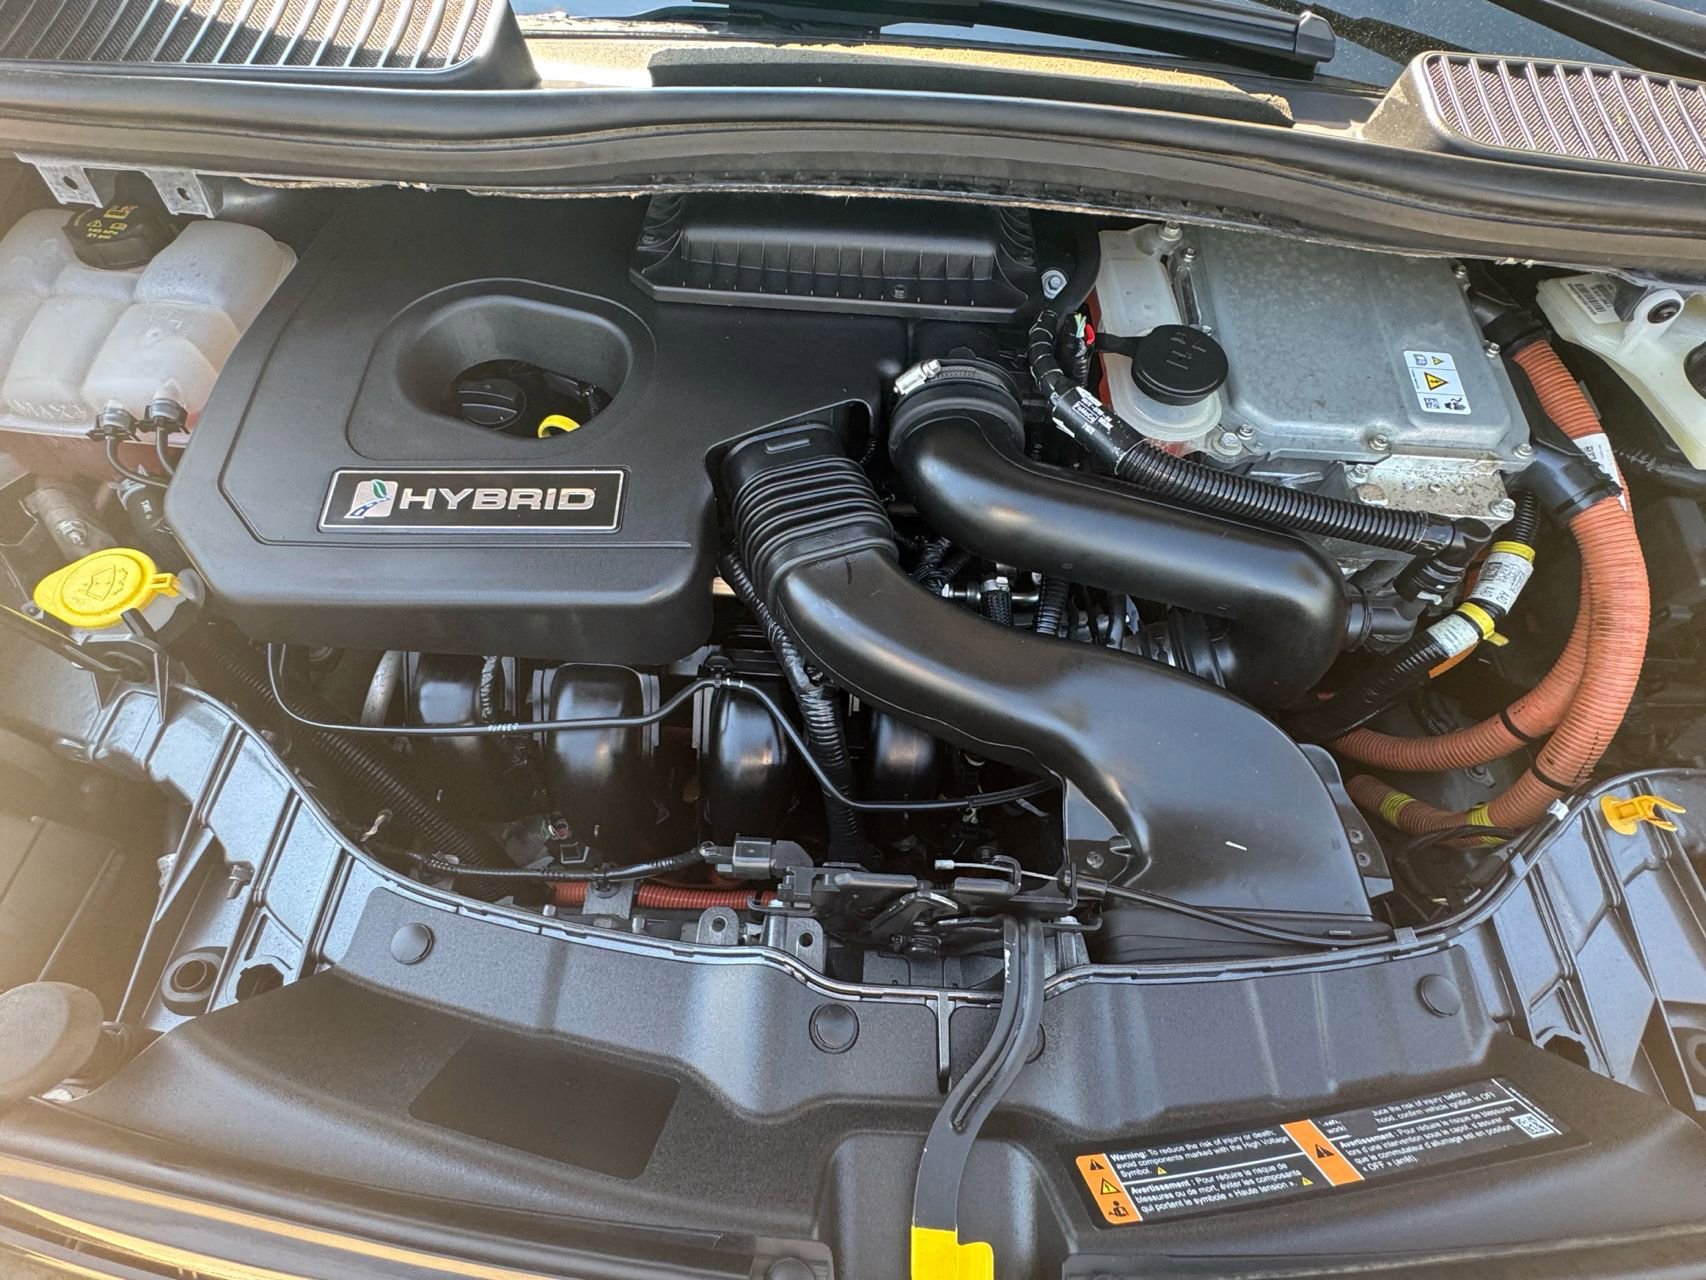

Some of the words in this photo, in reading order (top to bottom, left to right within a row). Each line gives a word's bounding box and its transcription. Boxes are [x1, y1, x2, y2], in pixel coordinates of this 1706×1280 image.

[400, 488, 596, 511] HYBRID
[1398, 1110, 1424, 1119] confirm
[1423, 1104, 1449, 1113] vehicle
[1448, 1098, 1475, 1109] ignition
[1443, 1091, 1468, 1101] before
[1340, 1132, 1395, 1148] Avertissement
[1397, 1128, 1416, 1136] Pour
[1449, 1116, 1471, 1124] risque
[1480, 1106, 1515, 1118] blessures
[1382, 1136, 1425, 1148] intervention
[1424, 1132, 1443, 1140] sous
[1110, 1150, 1148, 1162] Warning:
[1160, 1145, 1184, 1155] reduce
[1221, 1136, 1243, 1144] injury
[1116, 1161, 1138, 1170] avoid
[1138, 1154, 1184, 1166] components
[1185, 1150, 1214, 1160] marked
[1213, 1146, 1230, 1155] with
[1243, 1141, 1261, 1149] High
[1261, 1136, 1290, 1146] Voltage
[1354, 1158, 1370, 1166] que
[1378, 1144, 1425, 1159] commutateur
[1463, 1132, 1477, 1140] est
[1485, 1124, 1514, 1136] position
[1119, 1168, 1153, 1178] Symbol.
[1367, 1161, 1385, 1171] OFF
[1131, 1179, 1192, 1195] Avertissement
[1195, 1176, 1215, 1184] Pour
[1252, 1166, 1277, 1175] risque
[1135, 1192, 1175, 1204] blessures
[1256, 1170, 1302, 1184] composants
[1141, 1205, 1155, 1214] qui
[1155, 1200, 1185, 1212] portent
[1193, 1193, 1227, 1206] symbole
[1233, 1188, 1259, 1197] Haute
[1259, 1183, 1288, 1193] tension
